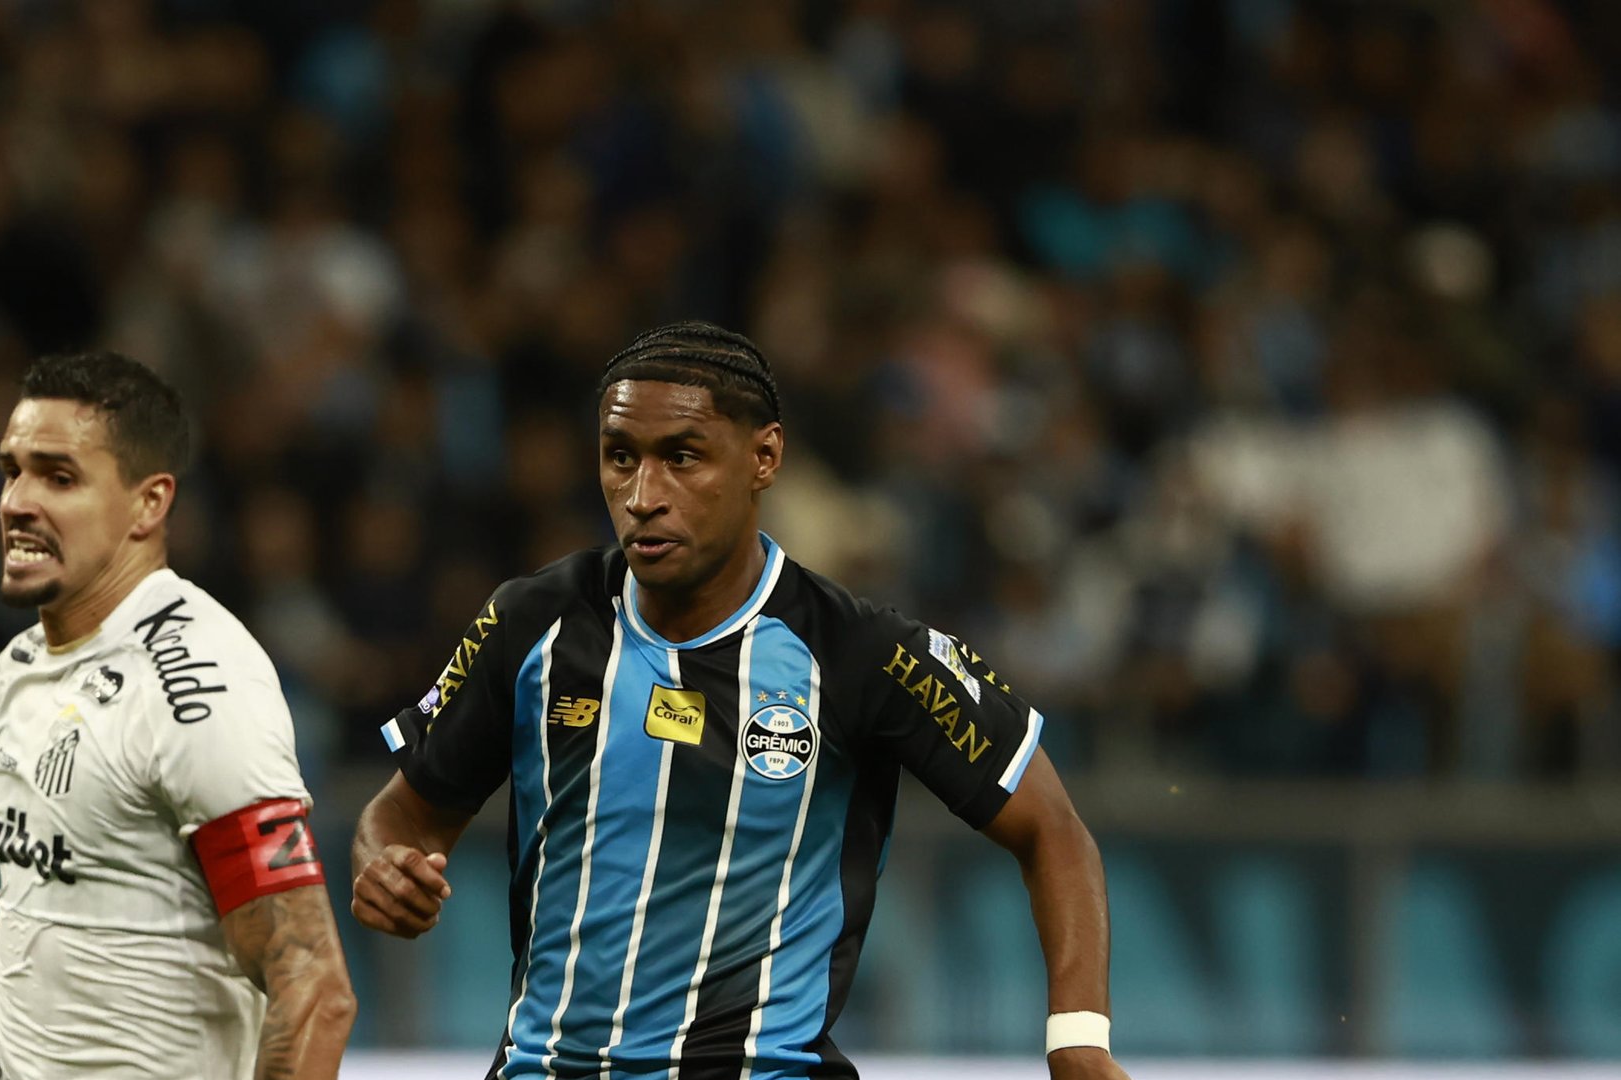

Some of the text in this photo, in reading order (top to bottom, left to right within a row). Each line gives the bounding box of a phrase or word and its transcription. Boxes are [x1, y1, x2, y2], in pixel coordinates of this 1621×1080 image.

[883, 643, 992, 763] HAVAN
[653, 704, 694, 727] Coral
[773, 718, 790, 728] 1903
[746, 731, 811, 755] GRÊMIO
